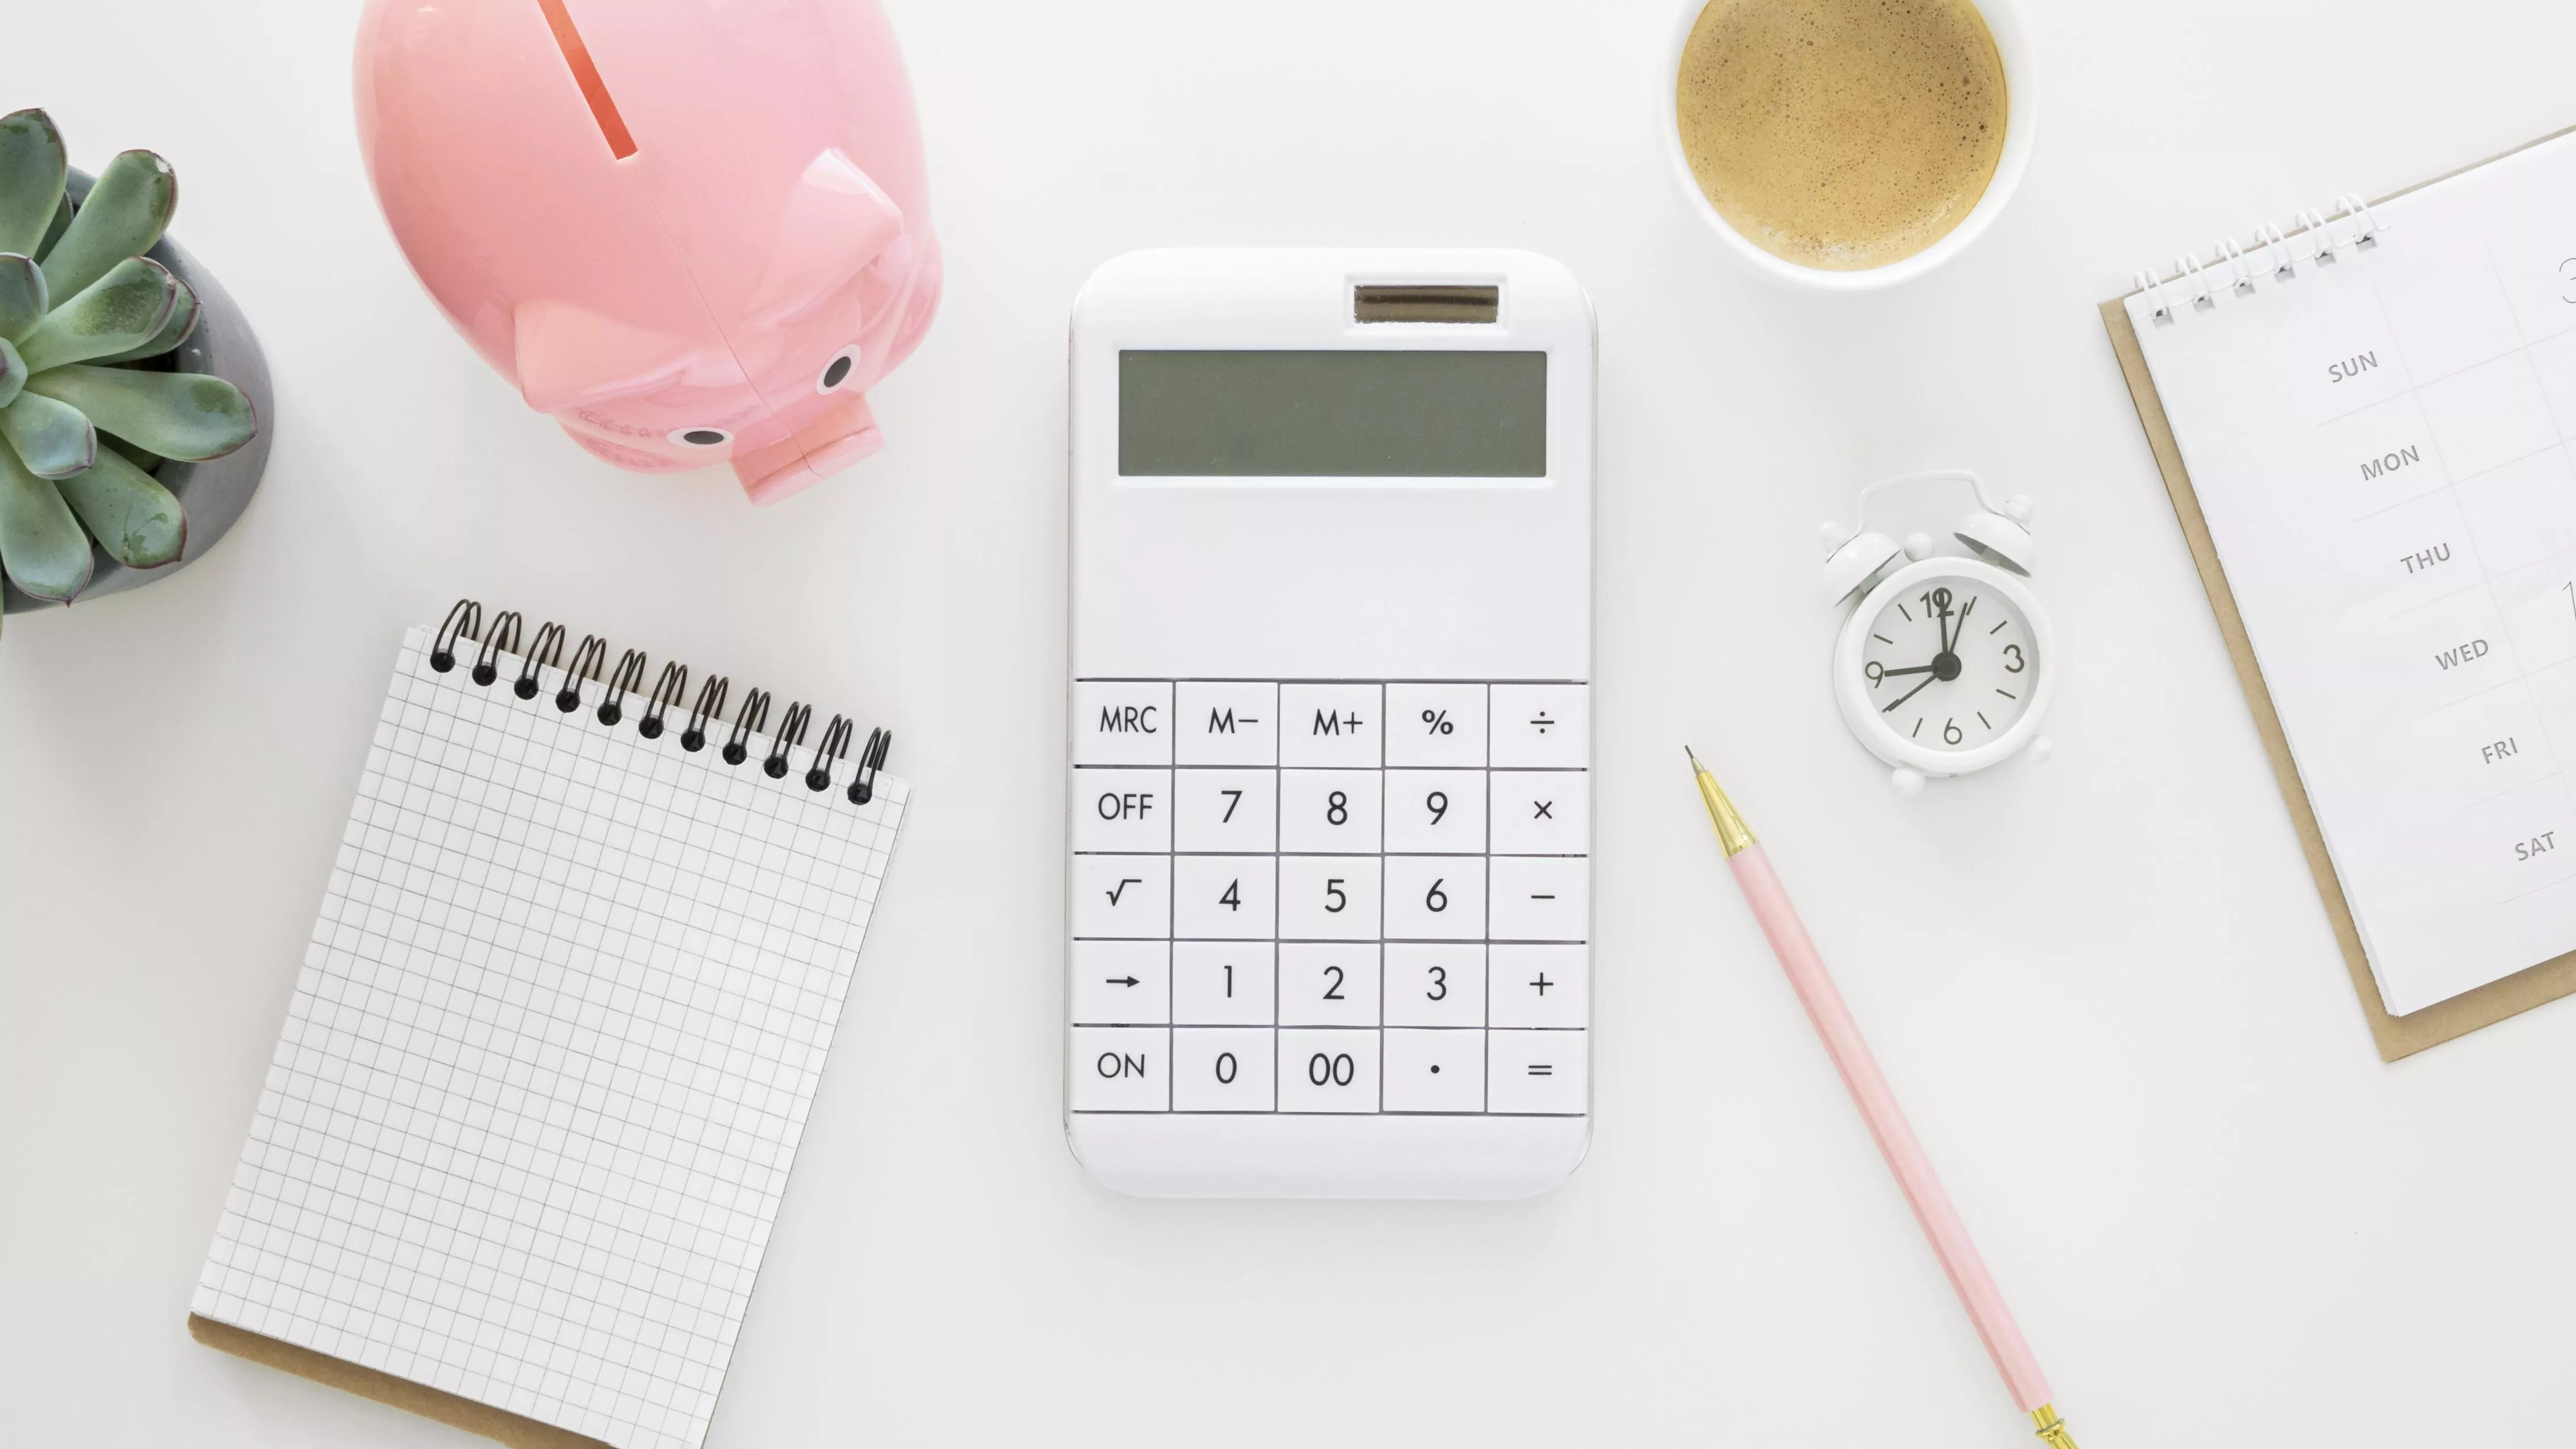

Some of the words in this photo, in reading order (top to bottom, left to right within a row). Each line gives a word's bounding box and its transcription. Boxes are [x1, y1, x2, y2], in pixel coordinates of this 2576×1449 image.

[2328, 350, 2378, 383] SUN
[2360, 445, 2420, 481] MON
[2400, 543, 2450, 574] THU
[1919, 587, 1954, 618] 12
[2003, 644, 2025, 673] 3
[2434, 639, 2488, 670] WED
[1865, 661, 1884, 689] 9
[1100, 706, 1157, 734] MRC
[1313, 709, 1363, 736] M+
[1422, 710, 1453, 735] %
[1944, 718, 1962, 745] 6
[2481, 737, 2519, 764] FRI
[1098, 792, 1153, 820] OFF
[1221, 790, 1243, 823] 7
[1327, 790, 1348, 826] 8
[1426, 791, 1448, 825] 9
[2515, 831, 2554, 862] SAT
[1219, 878, 1241, 912] 4
[1324, 879, 1346, 913] 5
[1426, 879, 1448, 912] 6
[1224, 965, 1232, 998] 1
[1323, 966, 1345, 1000] 2
[1426, 966, 1447, 1001] 3
[1097, 1052, 1145, 1078] ON
[1215, 1052, 1237, 1084] 0
[1309, 1053, 1355, 1086] 00
